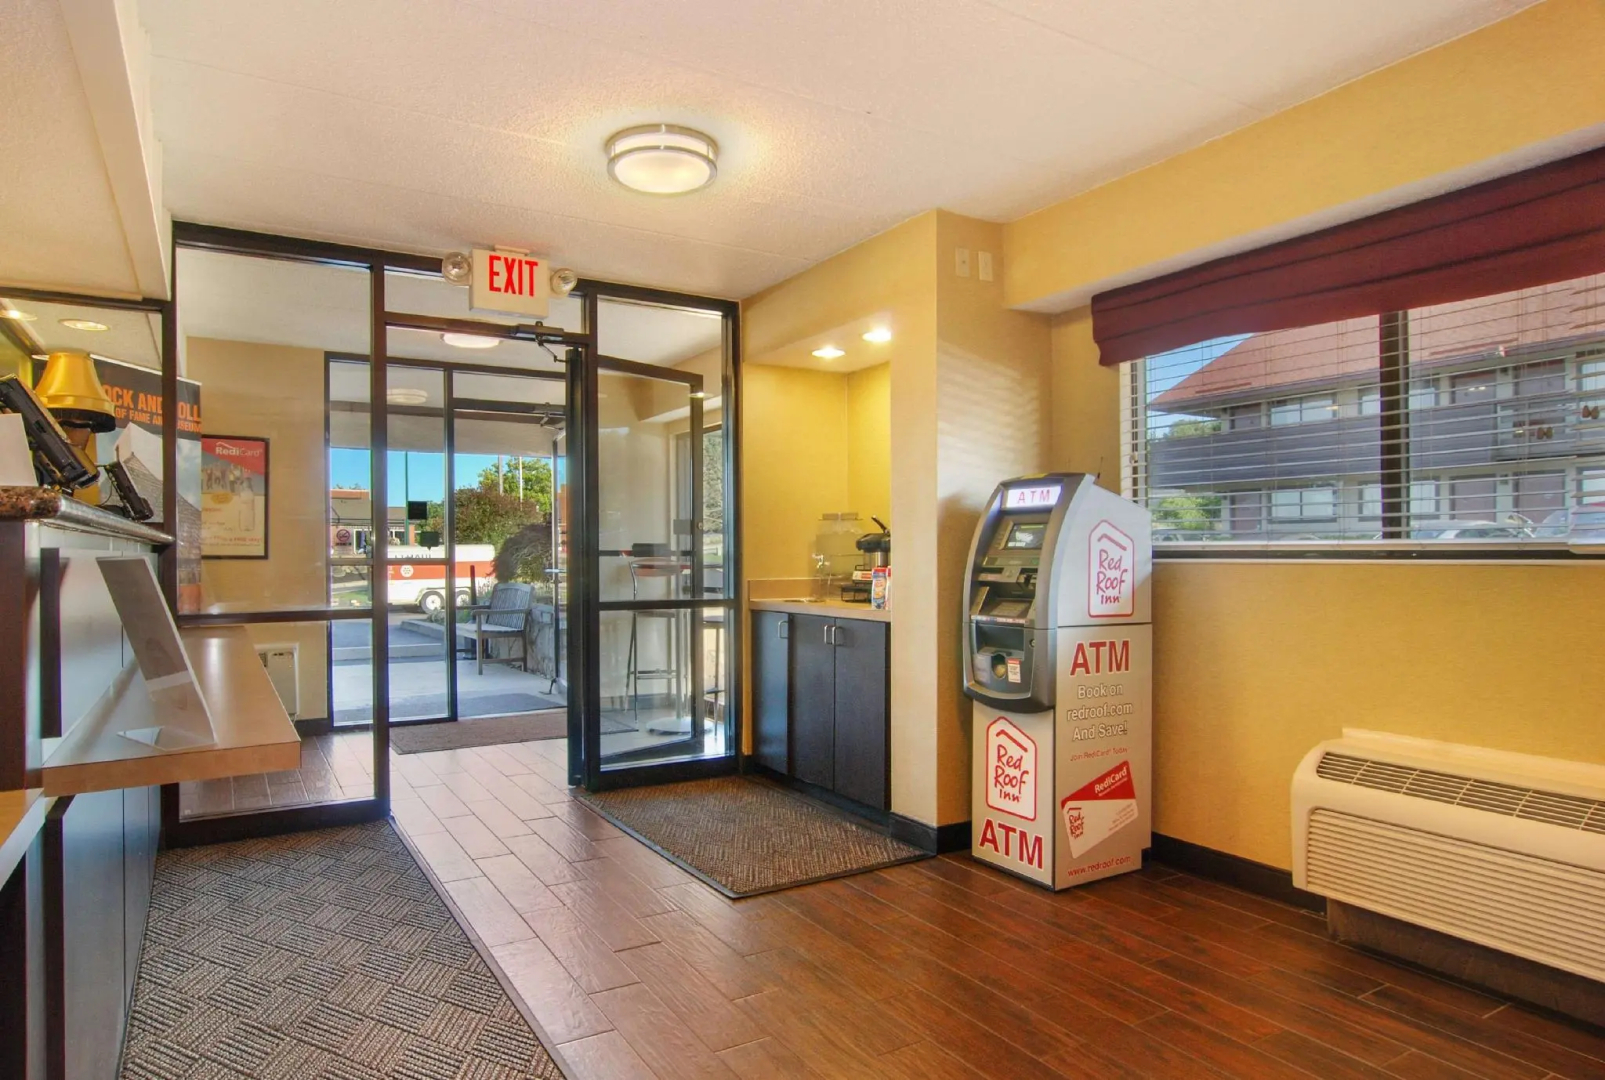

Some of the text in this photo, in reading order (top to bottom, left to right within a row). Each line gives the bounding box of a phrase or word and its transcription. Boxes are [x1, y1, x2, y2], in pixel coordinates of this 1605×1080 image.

[489, 254, 538, 297] EXIT
[102, 384, 134, 408] OCK
[178, 401, 200, 422] OLL
[115, 407, 127, 419] OF
[130, 408, 151, 424] FAME
[215, 446, 260, 457] RediCard
[1017, 489, 1050, 505] ATM
[1099, 548, 1122, 572] Red
[1096, 568, 1128, 595] Roof
[1069, 639, 1130, 676] ATM
[1077, 683, 1123, 700] Book on
[1067, 702, 1133, 721] redroof.com
[1072, 720, 1128, 742] And Save!
[997, 744, 1023, 771] Red
[994, 765, 1029, 795] Roof
[1094, 766, 1128, 794] RediCard
[979, 818, 1043, 870] ATM
[1067, 856, 1131, 877] www.redroof.com
